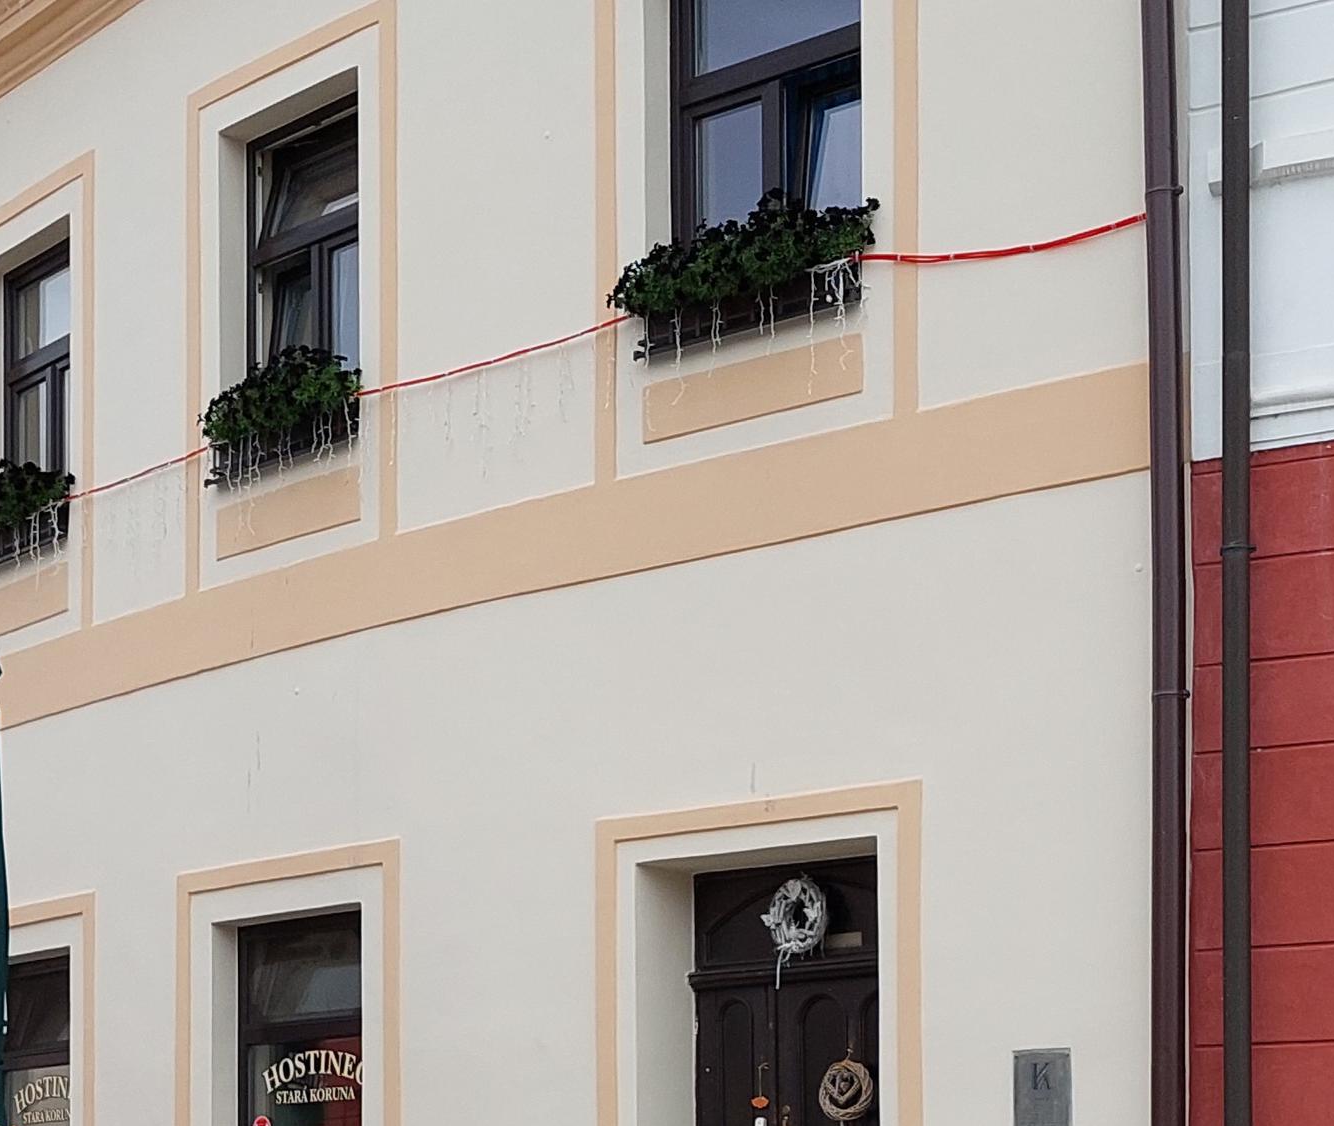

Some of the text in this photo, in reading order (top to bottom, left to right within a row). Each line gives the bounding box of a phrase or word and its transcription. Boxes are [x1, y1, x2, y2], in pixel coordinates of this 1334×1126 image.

[14, 1076, 72, 1114] HOSTIN
[275, 1085, 356, 1104] STARÁ KORUNA
[45, 1108, 71, 1122] KORUN
